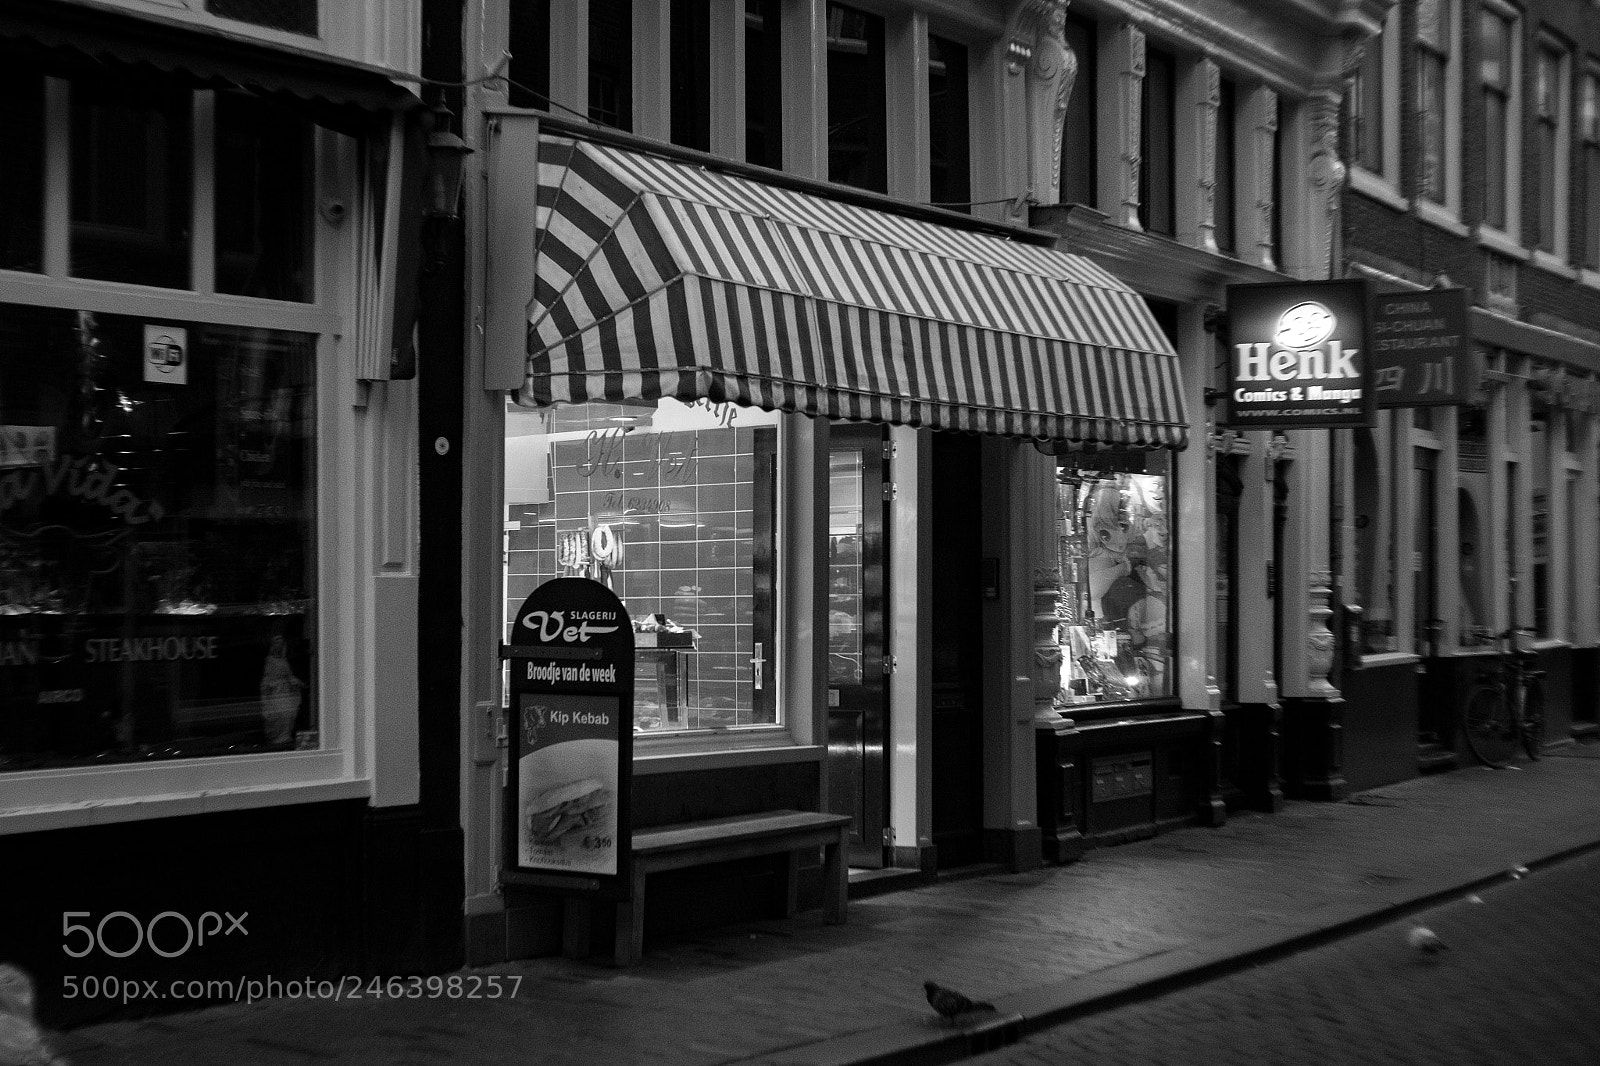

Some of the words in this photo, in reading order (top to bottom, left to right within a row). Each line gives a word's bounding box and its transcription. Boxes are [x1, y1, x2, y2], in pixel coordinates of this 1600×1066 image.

[1386, 302, 1432, 315] CHINA
[1235, 340, 1360, 381] Henk
[1233, 387, 1288, 402] Comics
[1290, 386, 1304, 401] &
[1306, 385, 1363, 404] Manga
[522, 610, 620, 643] Vet
[570, 610, 617, 621] SLAGERIJ
[84, 636, 219, 663] STEAKHOUSE
[527, 661, 561, 686] Broodje
[562, 666, 578, 682] van
[579, 662, 591, 682] de
[592, 663, 616, 683] week
[550, 710, 570, 726] Kip
[572, 711, 610, 725] Kebab
